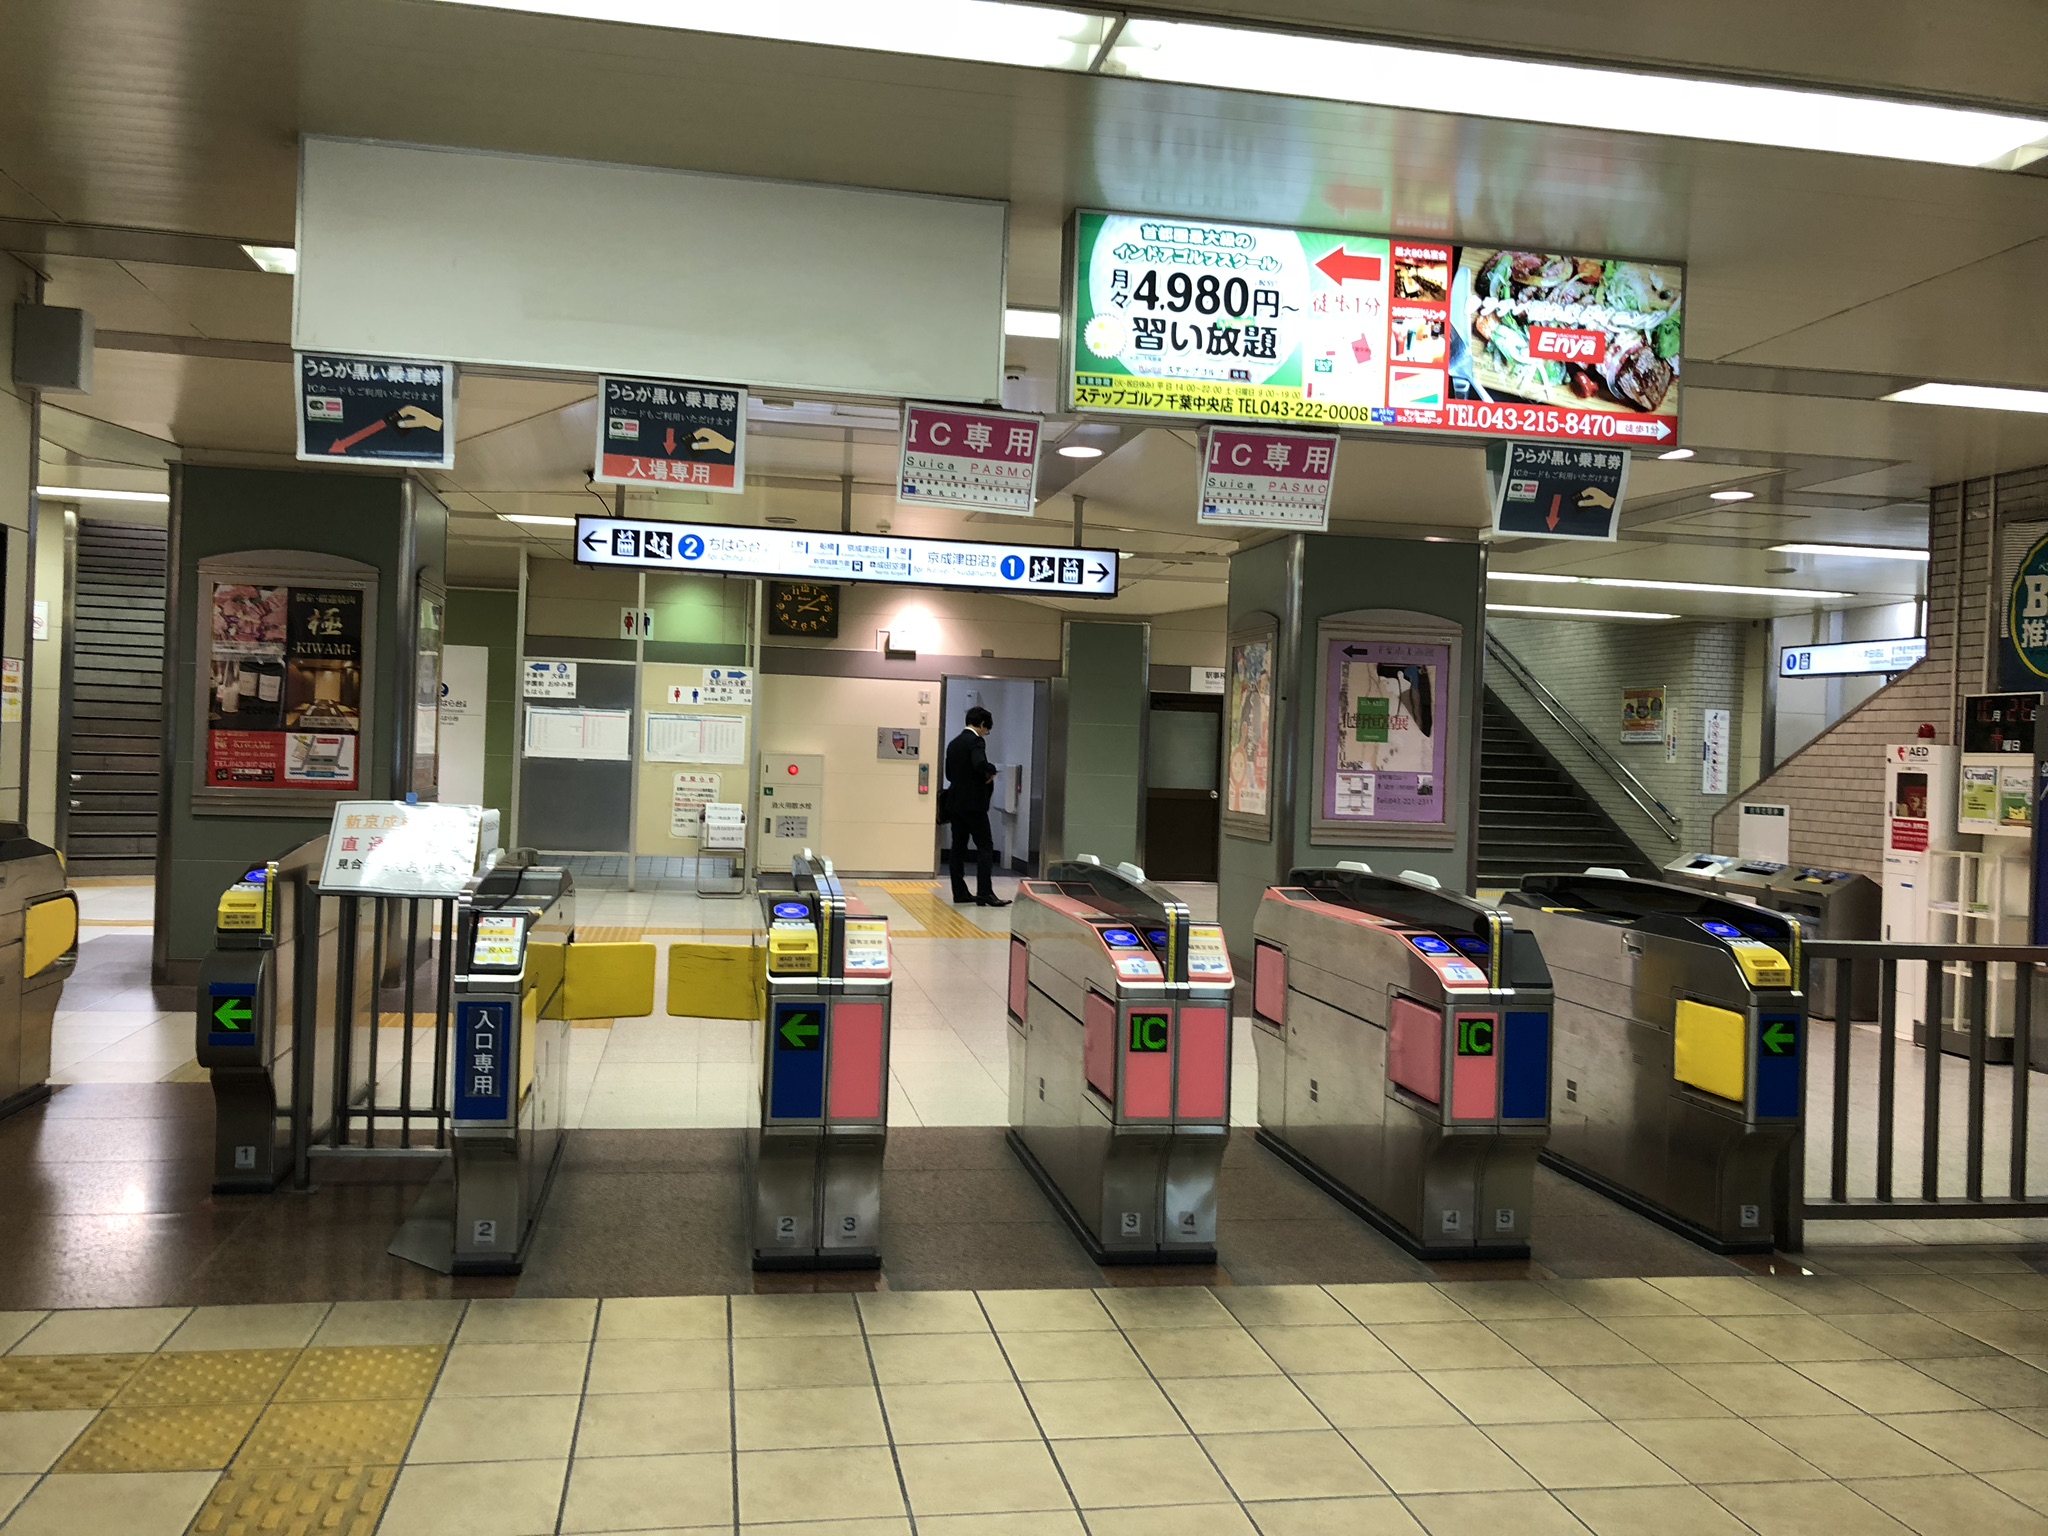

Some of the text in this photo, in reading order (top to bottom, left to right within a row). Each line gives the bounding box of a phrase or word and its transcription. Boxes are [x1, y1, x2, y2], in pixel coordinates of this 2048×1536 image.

[1113, 243, 1280, 273] インドアゴルフスクール
[1132, 317, 1278, 359] 習い放題
[1537, 331, 1596, 359] Enya
[304, 358, 442, 387] うらが黒い乗車券
[607, 383, 737, 412] うらが黒い乗車券
[1076, 387, 1234, 413] ステップゴルフ千葉中央店
[609, 406, 733, 426] ICカードもご利用いただけます
[908, 419, 1034, 457] IC専用
[906, 456, 1032, 478] Suica PASMO
[1211, 441, 1331, 474] IC専用
[1513, 447, 1621, 470] うらが黒い乗車券
[627, 458, 711, 484] 入場専用
[1207, 477, 1327, 494] Suica PASMO
[684, 537, 761, 557] 2 ちはら台
[926, 550, 990, 568] 京成津田沼
[1008, 558, 1016, 577] 1
[2021, 618, 2048, 648] 推
[1909, 746, 1929, 757] AED
[1132, 1017, 1166, 1050] IC
[1459, 1021, 1492, 1053] IC
[473, 1010, 495, 1095] 入口専用
[241, 1148, 248, 1161] 1
[781, 1217, 794, 1232] 2
[843, 1216, 857, 1231] 3
[1125, 1213, 1138, 1228] 3
[1184, 1213, 1195, 1226] 4
[1446, 1211, 1457, 1224] 4
[1500, 1210, 1511, 1224] 5
[478, 1222, 492, 1237] 2
